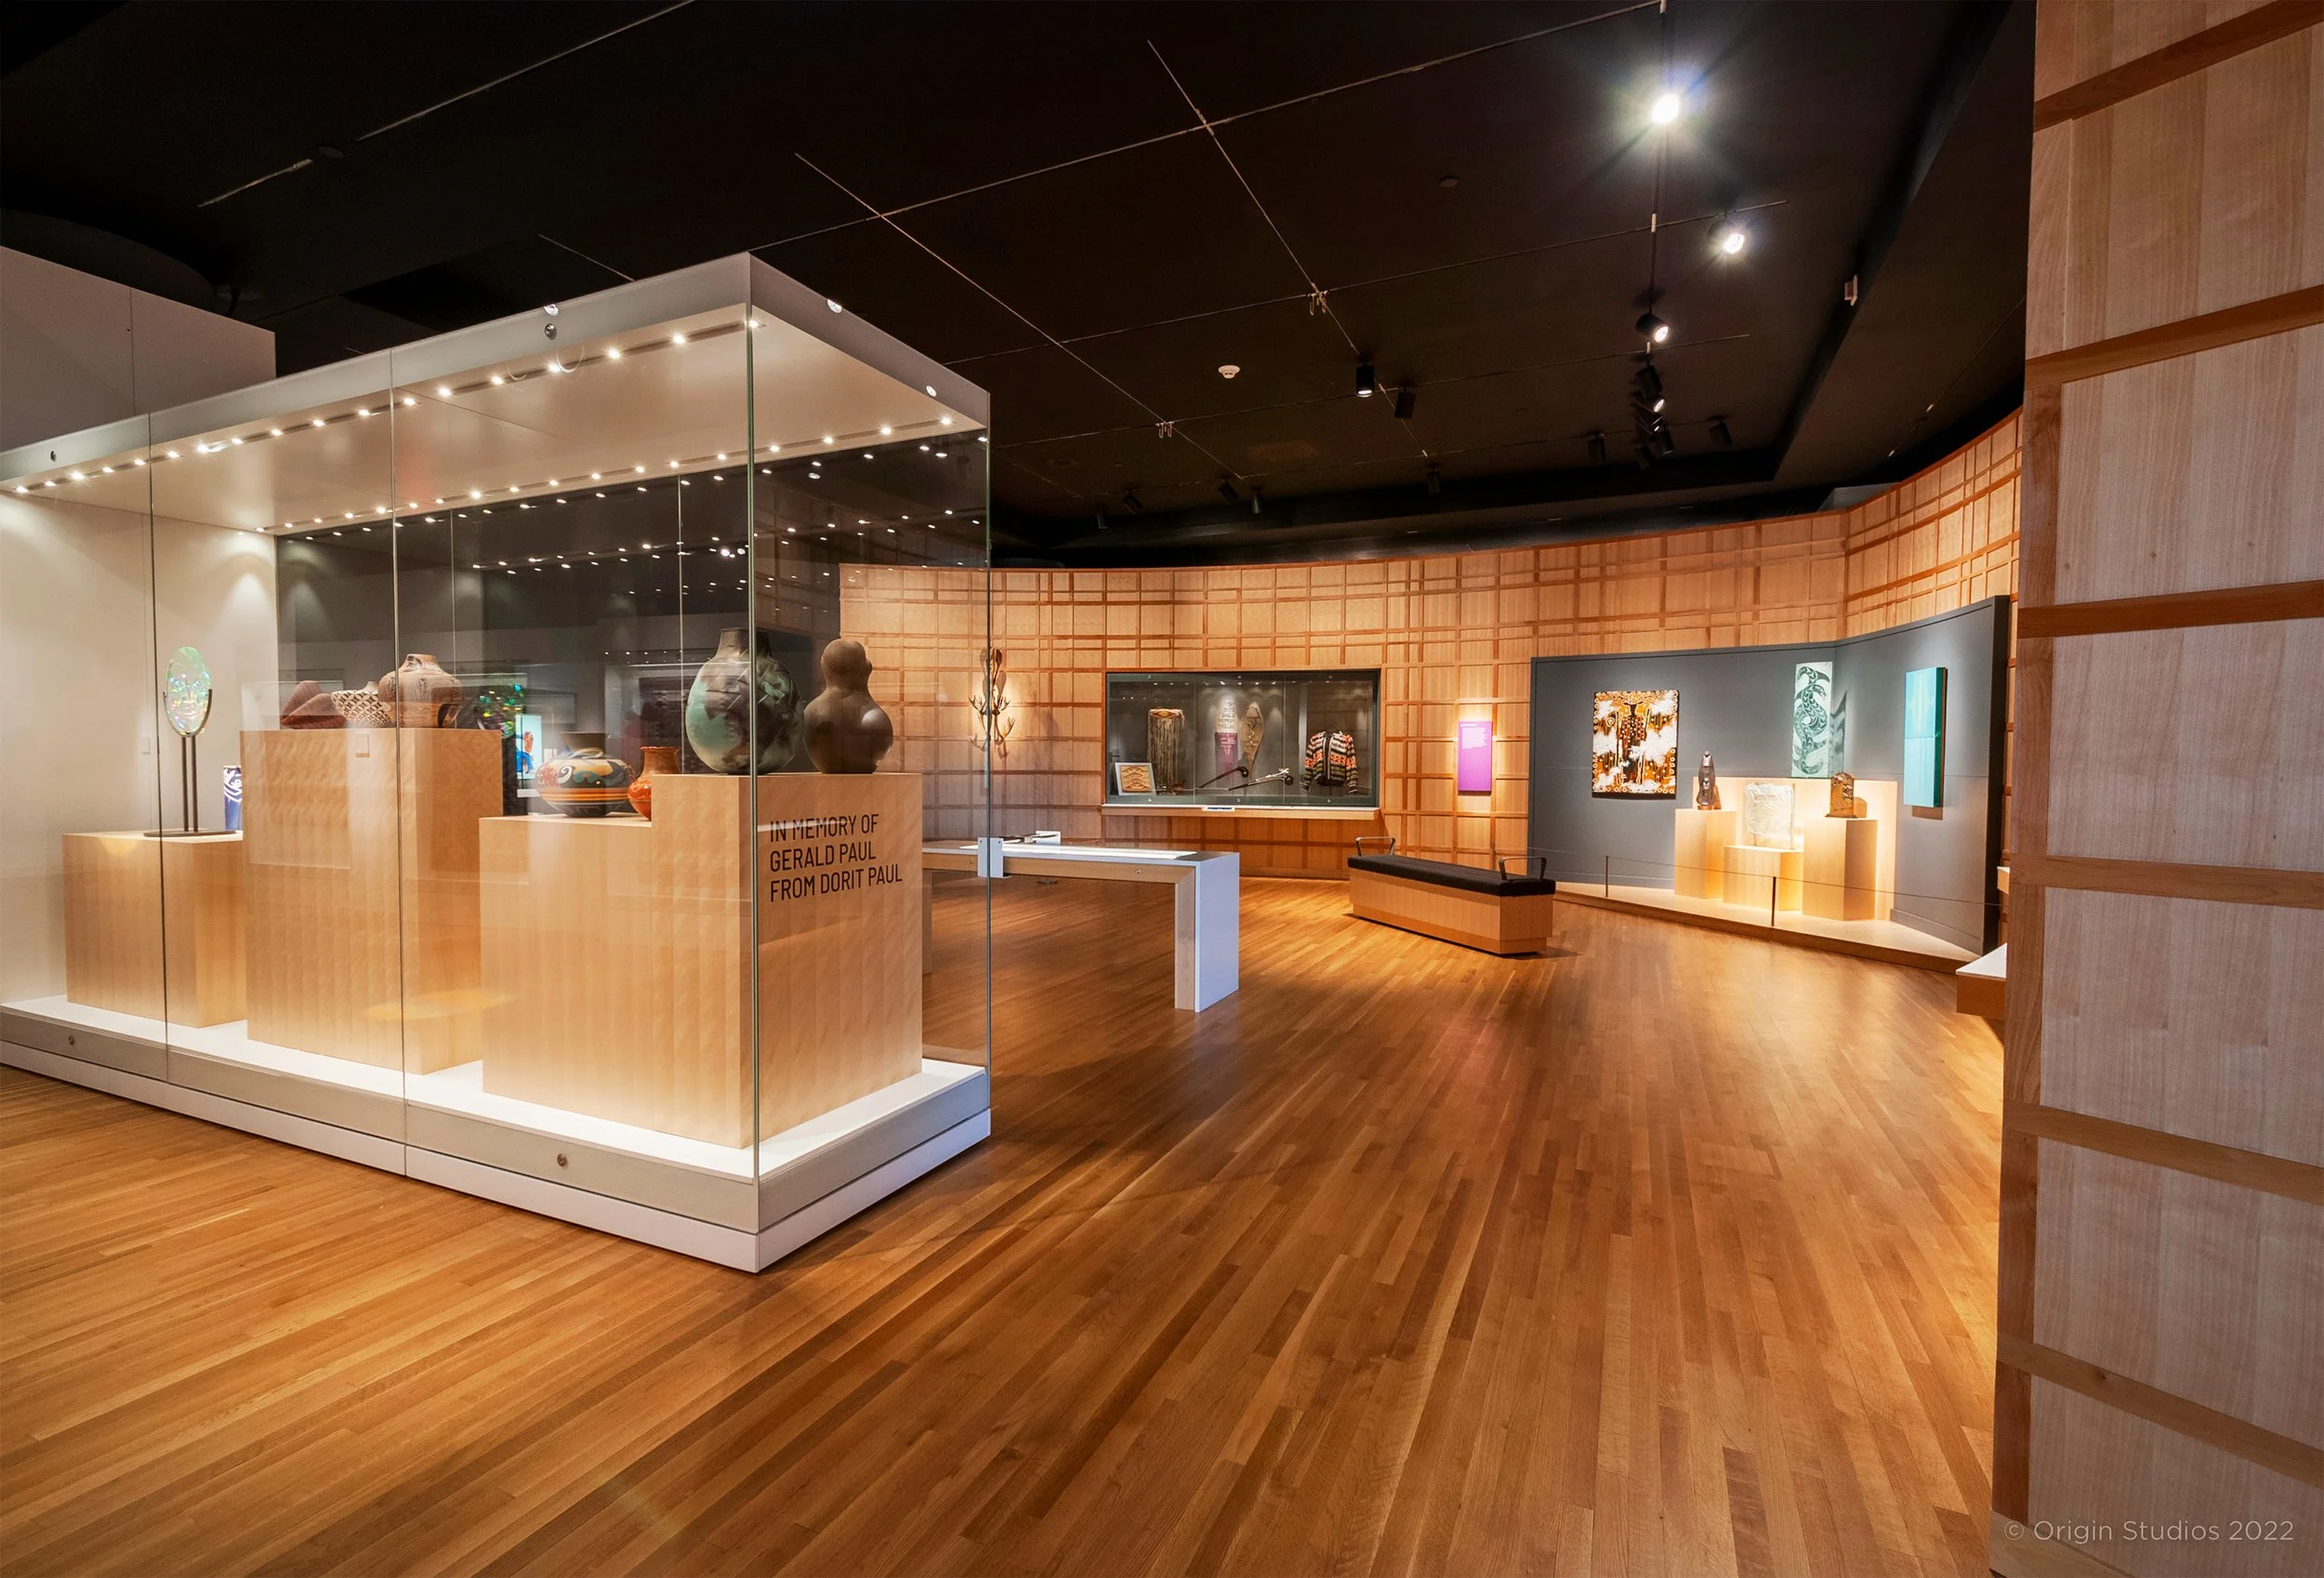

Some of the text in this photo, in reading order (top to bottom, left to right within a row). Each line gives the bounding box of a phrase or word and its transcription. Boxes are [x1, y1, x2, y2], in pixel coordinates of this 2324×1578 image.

[770, 814, 879, 842] IN MEMORY OF
[770, 840, 877, 873] GERALD PAUL
[771, 863, 903, 902] FROM DORIT PAUL
